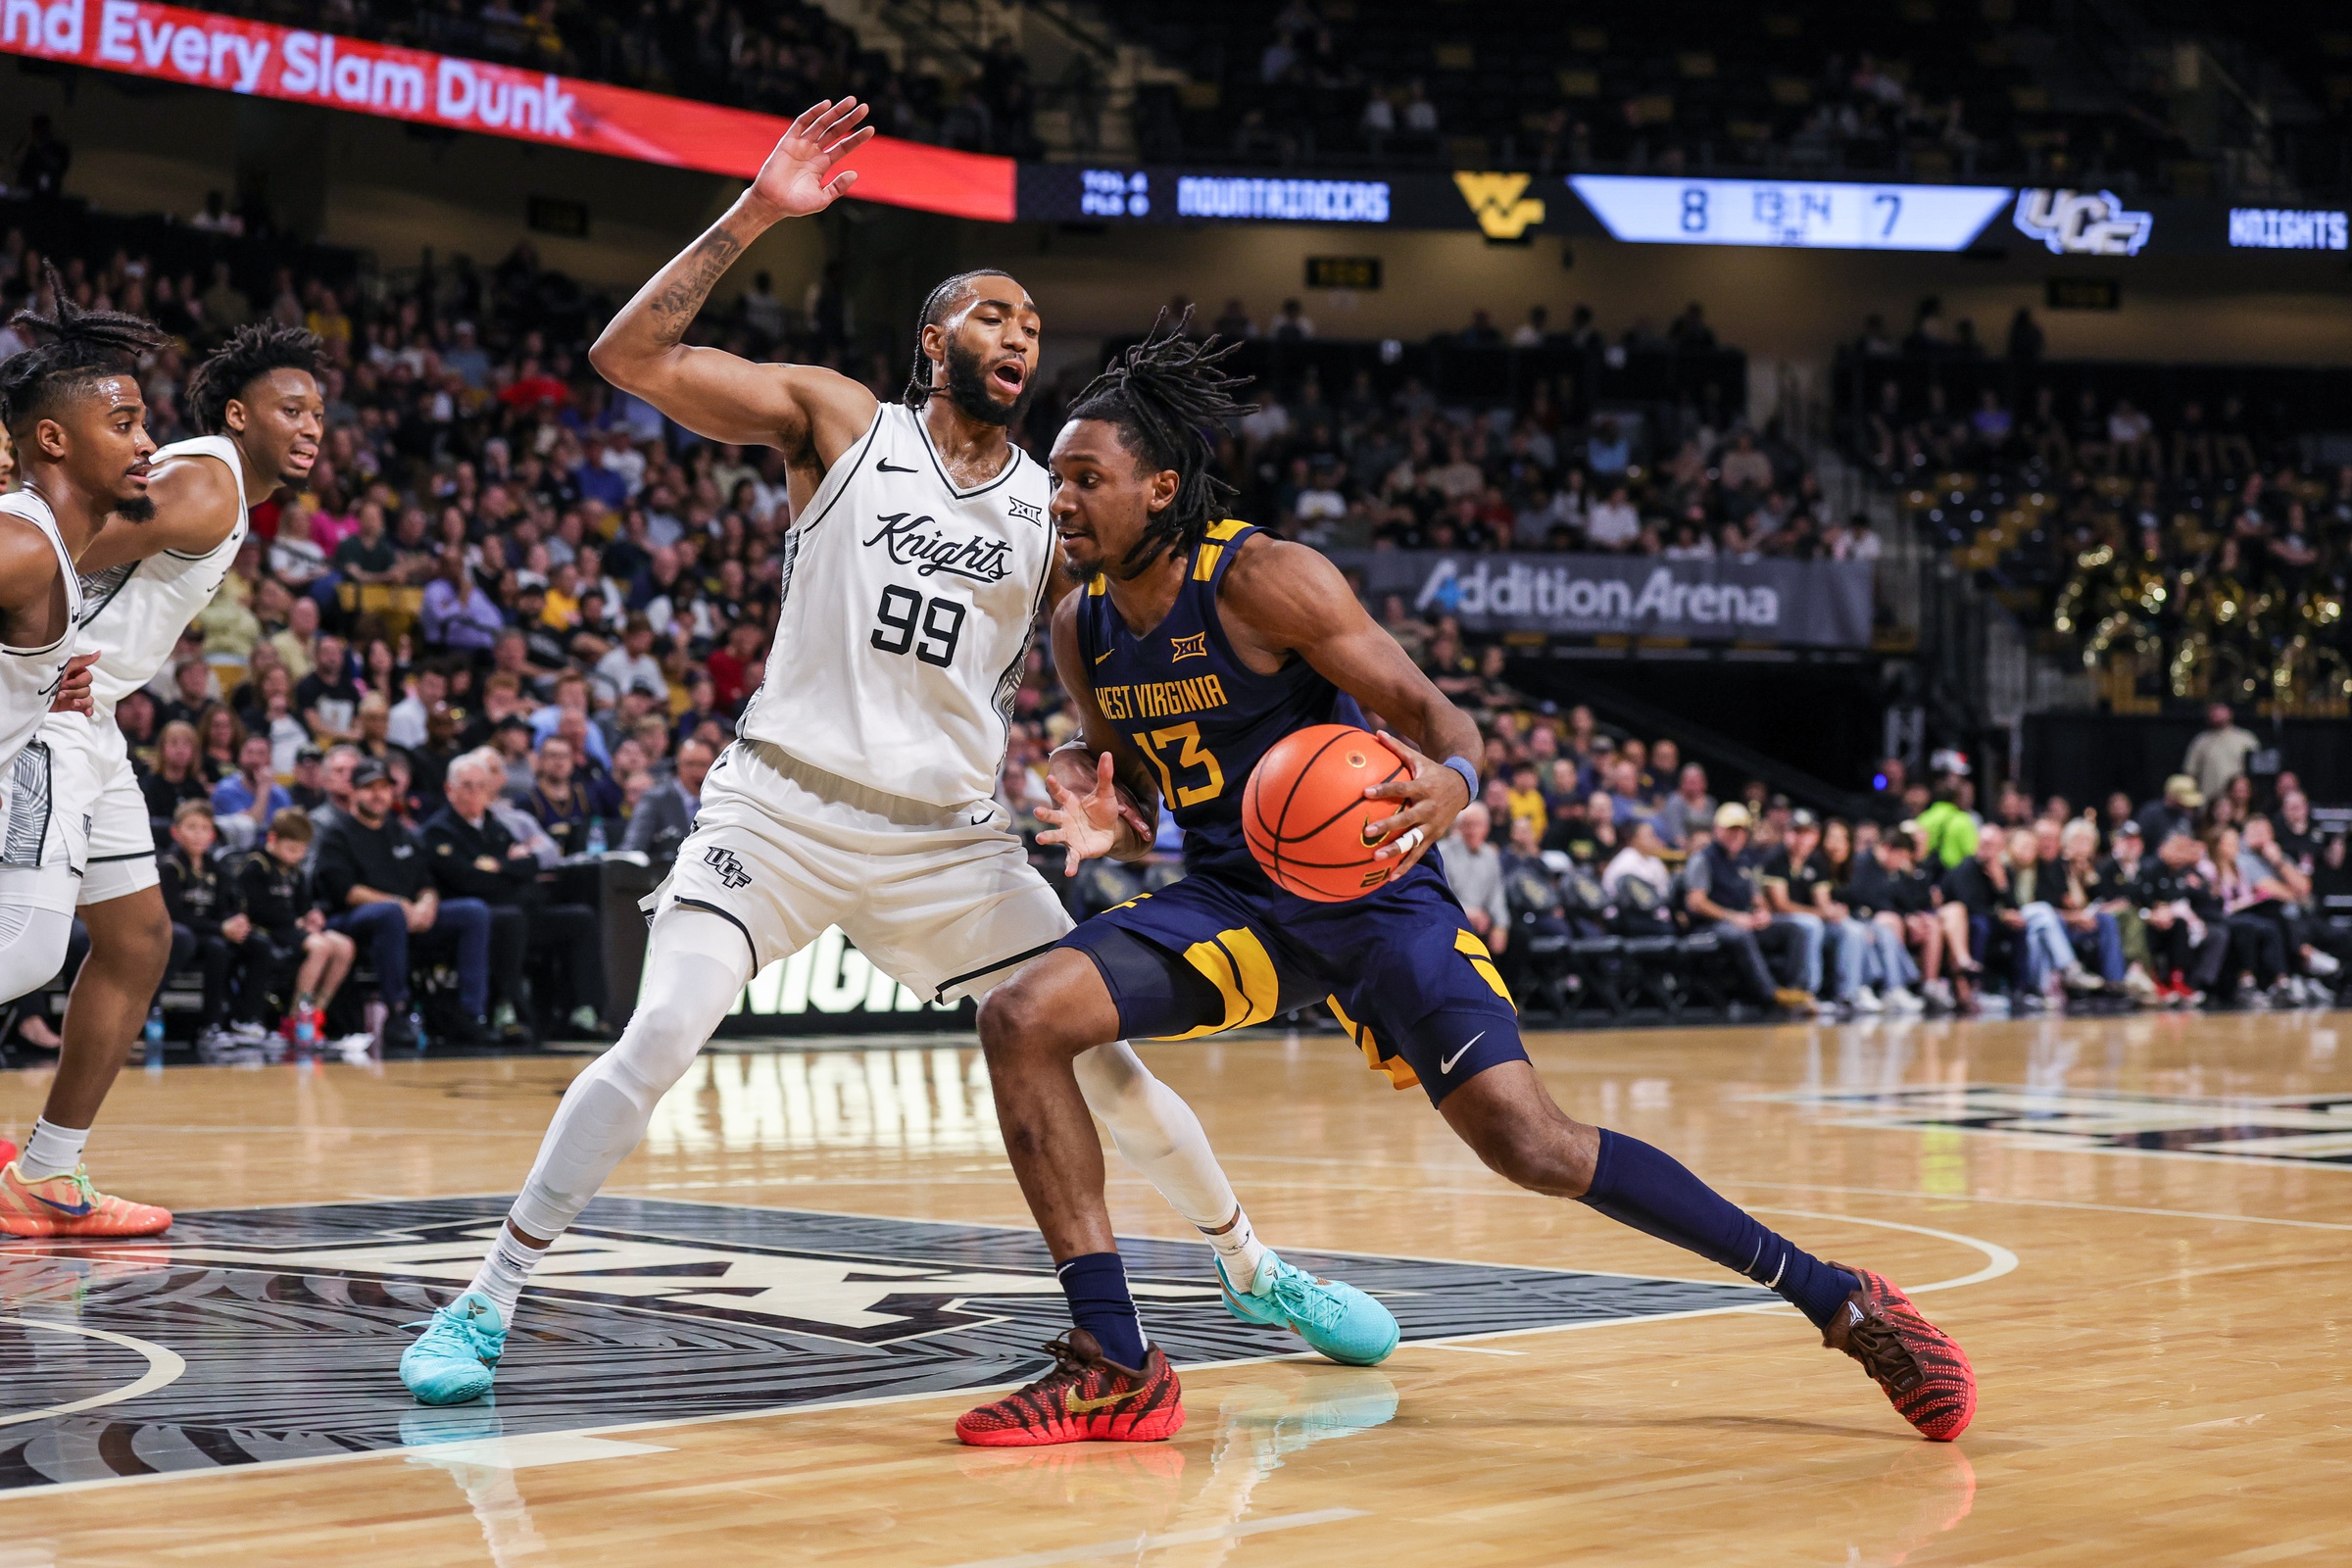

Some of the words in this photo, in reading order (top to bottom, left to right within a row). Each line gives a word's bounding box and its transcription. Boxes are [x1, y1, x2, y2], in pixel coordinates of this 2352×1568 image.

[99, 1, 270, 94] Every
[280, 29, 425, 112] Slam
[436, 56, 575, 139] Dunk
[1177, 175, 1391, 222] MOUNTAINEERS
[1681, 187, 1709, 233] 8
[1874, 193, 1902, 238] 7
[2013, 188, 2154, 256] UCF
[2229, 207, 2349, 250] KNIGHTS
[862, 513, 1012, 583] Knights
[1633, 566, 1780, 625] Arena
[870, 583, 966, 668] 99
[1095, 685, 1134, 720] WEST
[1133, 673, 1228, 718] VIRGINIA
[1132, 720, 1225, 810] 13
[704, 846, 753, 889] UCF
